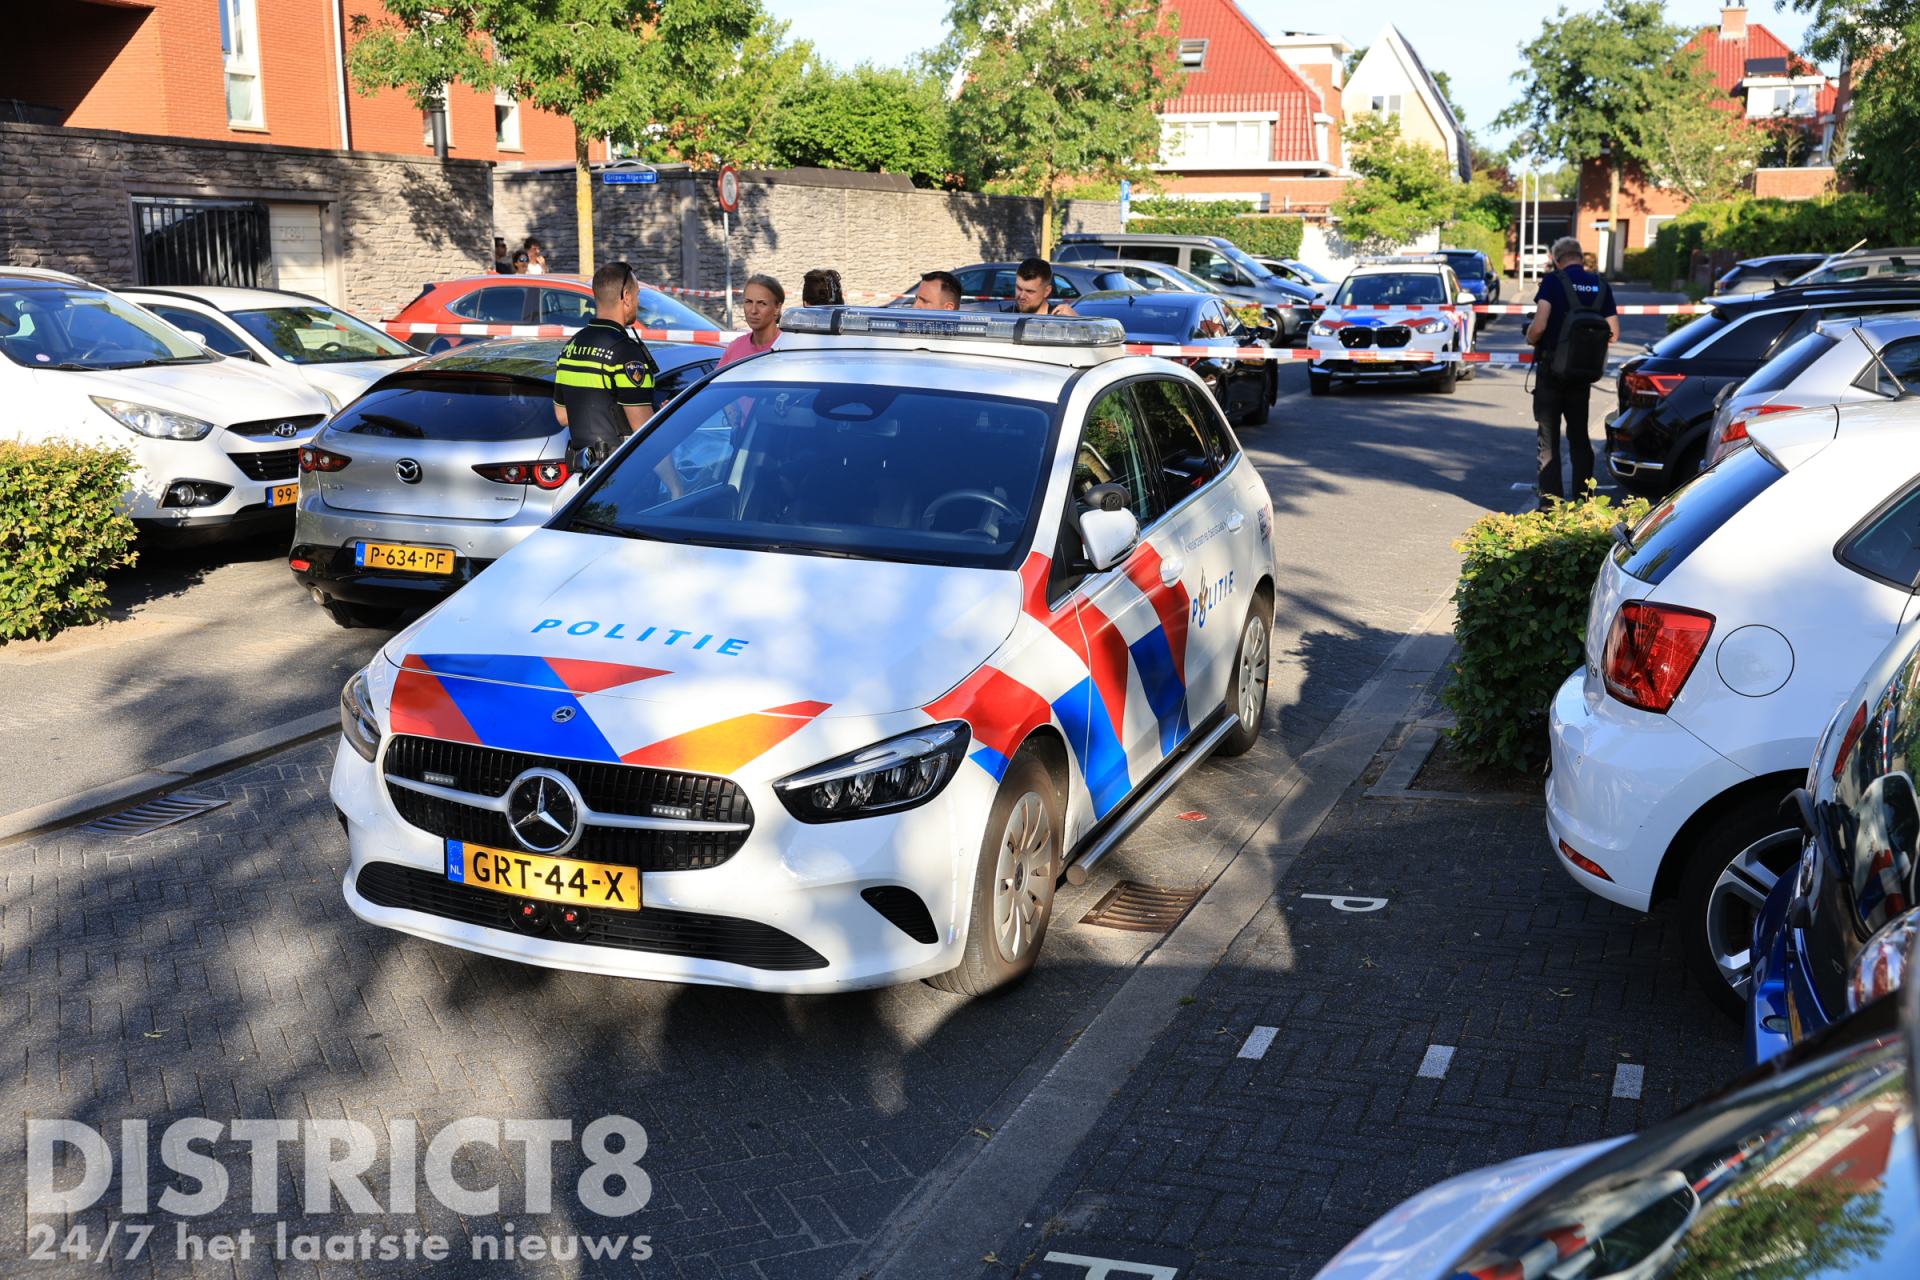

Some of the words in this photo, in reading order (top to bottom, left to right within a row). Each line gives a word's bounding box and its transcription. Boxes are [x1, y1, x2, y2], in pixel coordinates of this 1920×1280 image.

[1572, 284, 1592, 292] EGIO
[277, 486, 298, 502] 99-
[370, 547, 446, 569] P-634-PF
[1192, 569, 1234, 628] POLITIE
[530, 618, 749, 656] POLITIE
[450, 864, 462, 876] NL
[473, 851, 625, 902] GRT-44-X
[1301, 893, 1389, 912] P
